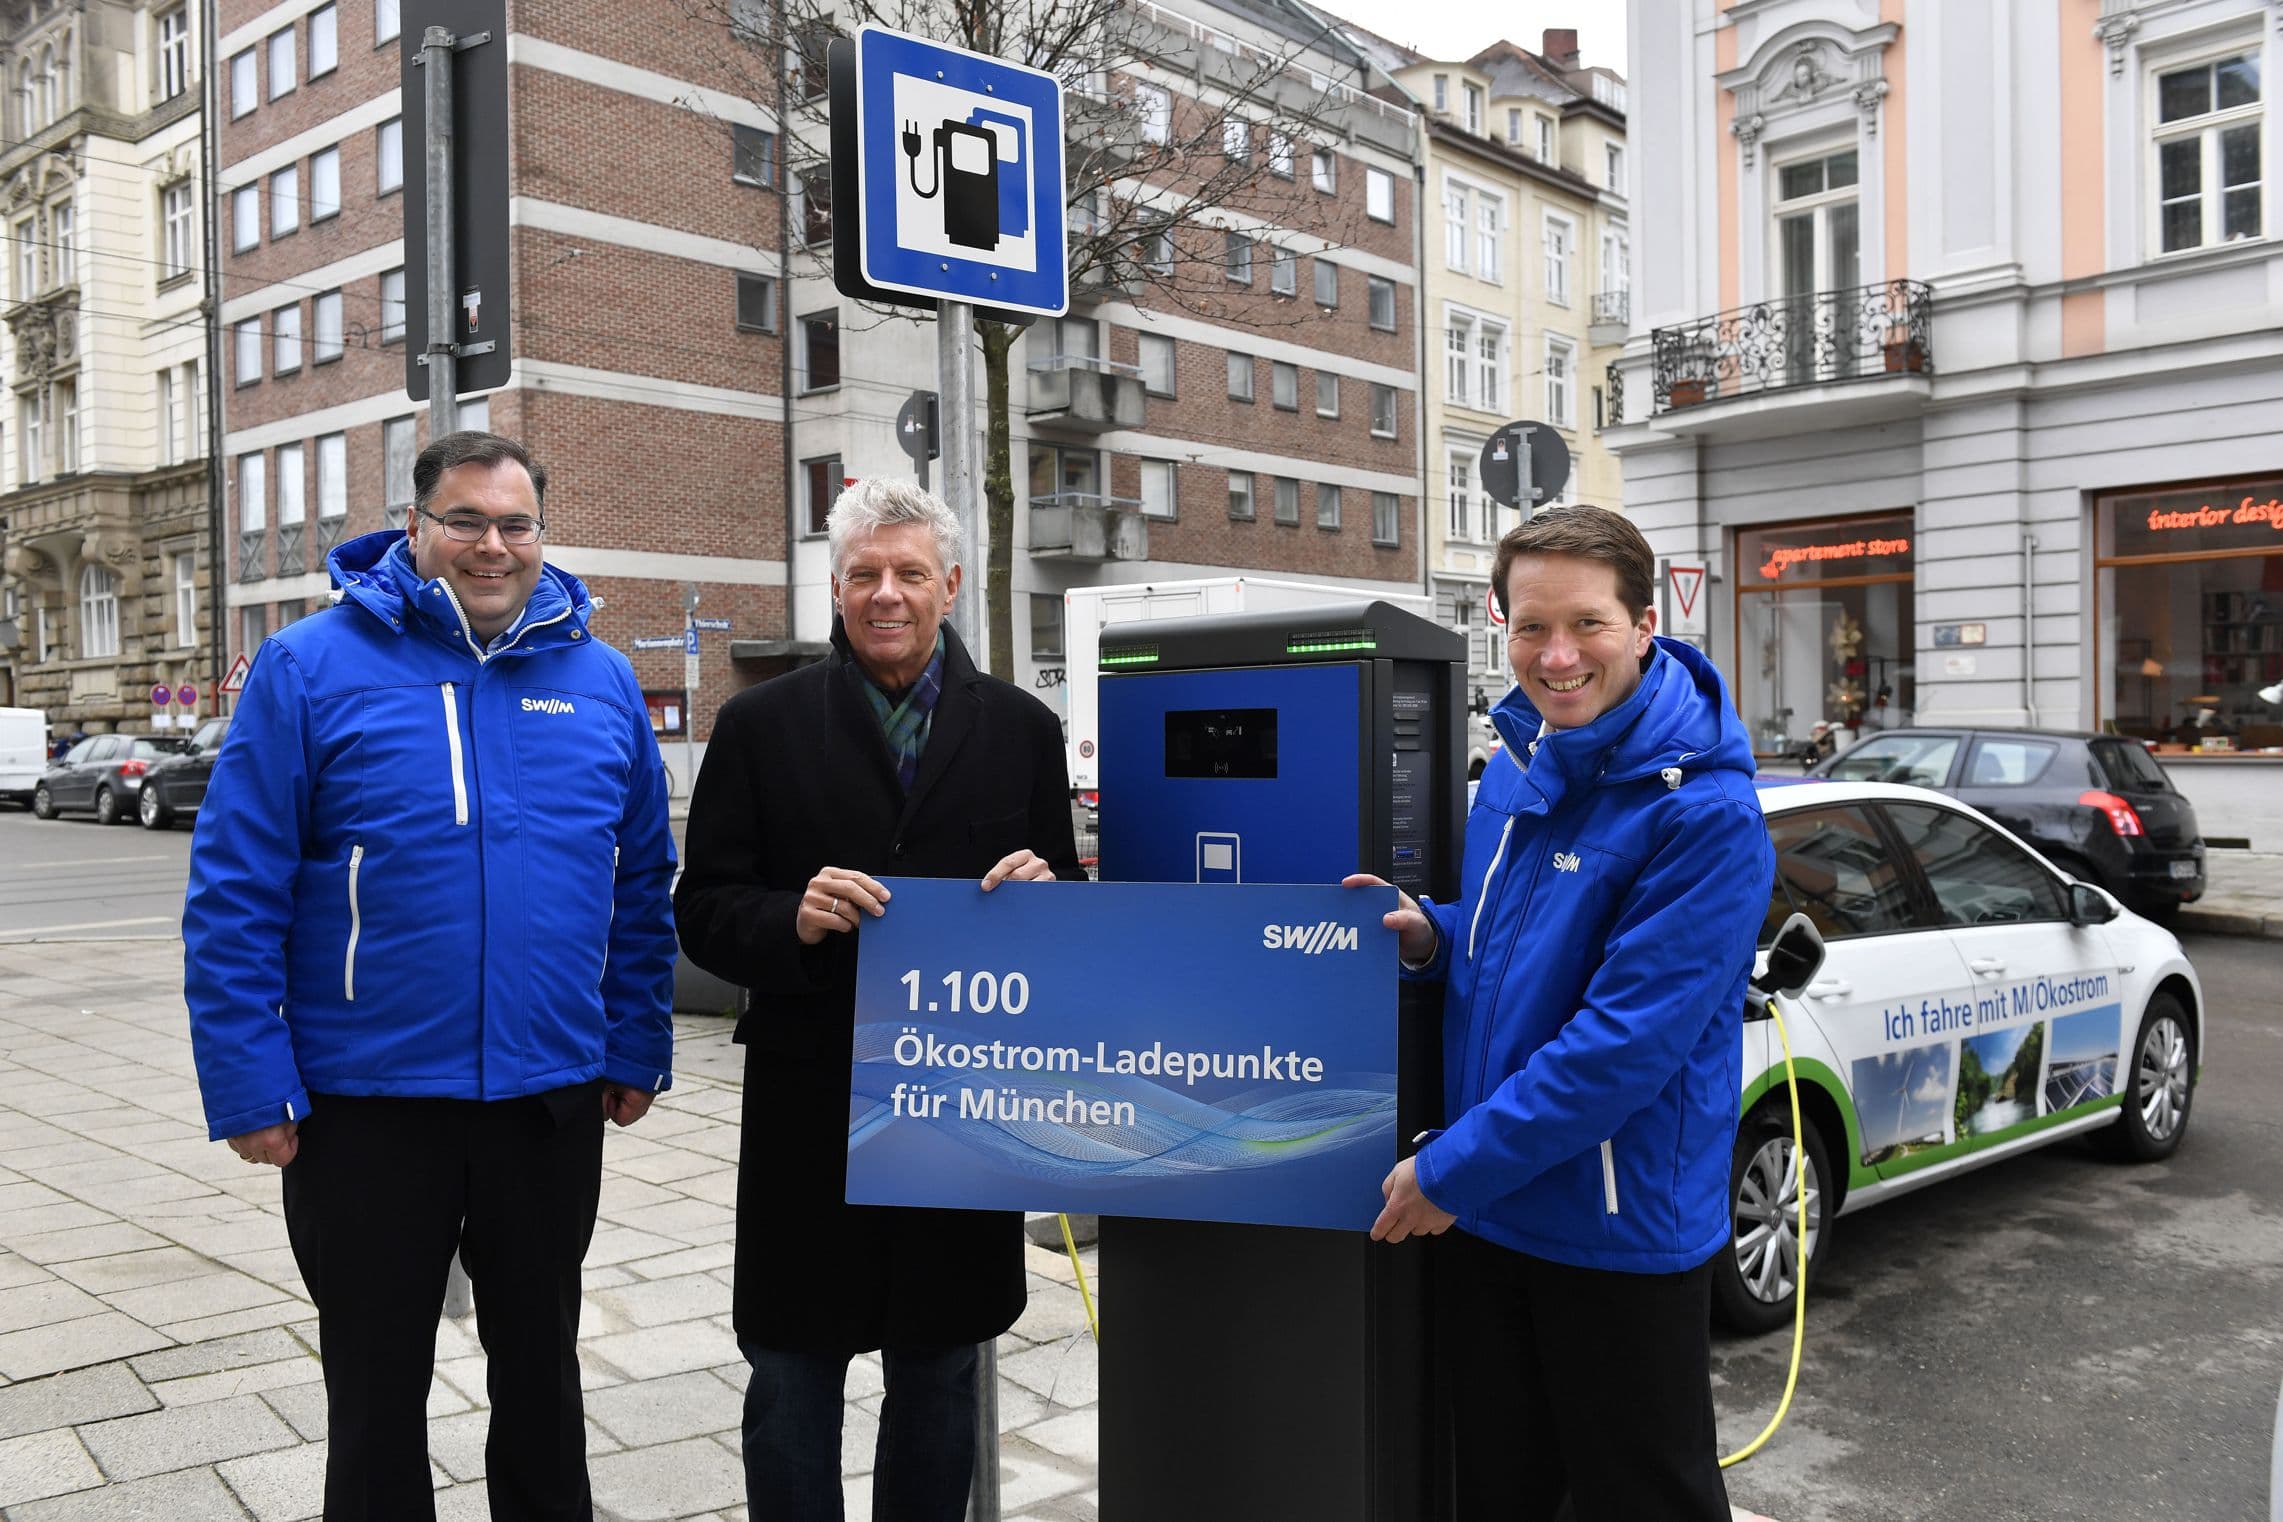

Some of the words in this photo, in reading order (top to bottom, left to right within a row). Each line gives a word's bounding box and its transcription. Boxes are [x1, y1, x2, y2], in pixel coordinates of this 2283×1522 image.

[2147, 505, 2232, 530] interior
[1867, 538, 1909, 556] store
[900, 969, 1030, 1015] 1.100
[1885, 1005, 1914, 1040] Ich
[1921, 998, 1972, 1034] fahre
[1979, 988, 2007, 1023] mit
[2013, 975, 2109, 1015] M/Ökostrom
[894, 1027, 1324, 1085] Ökostrom-Ladepunkte
[890, 1083, 947, 1118] für
[959, 1087, 1135, 1126] München
